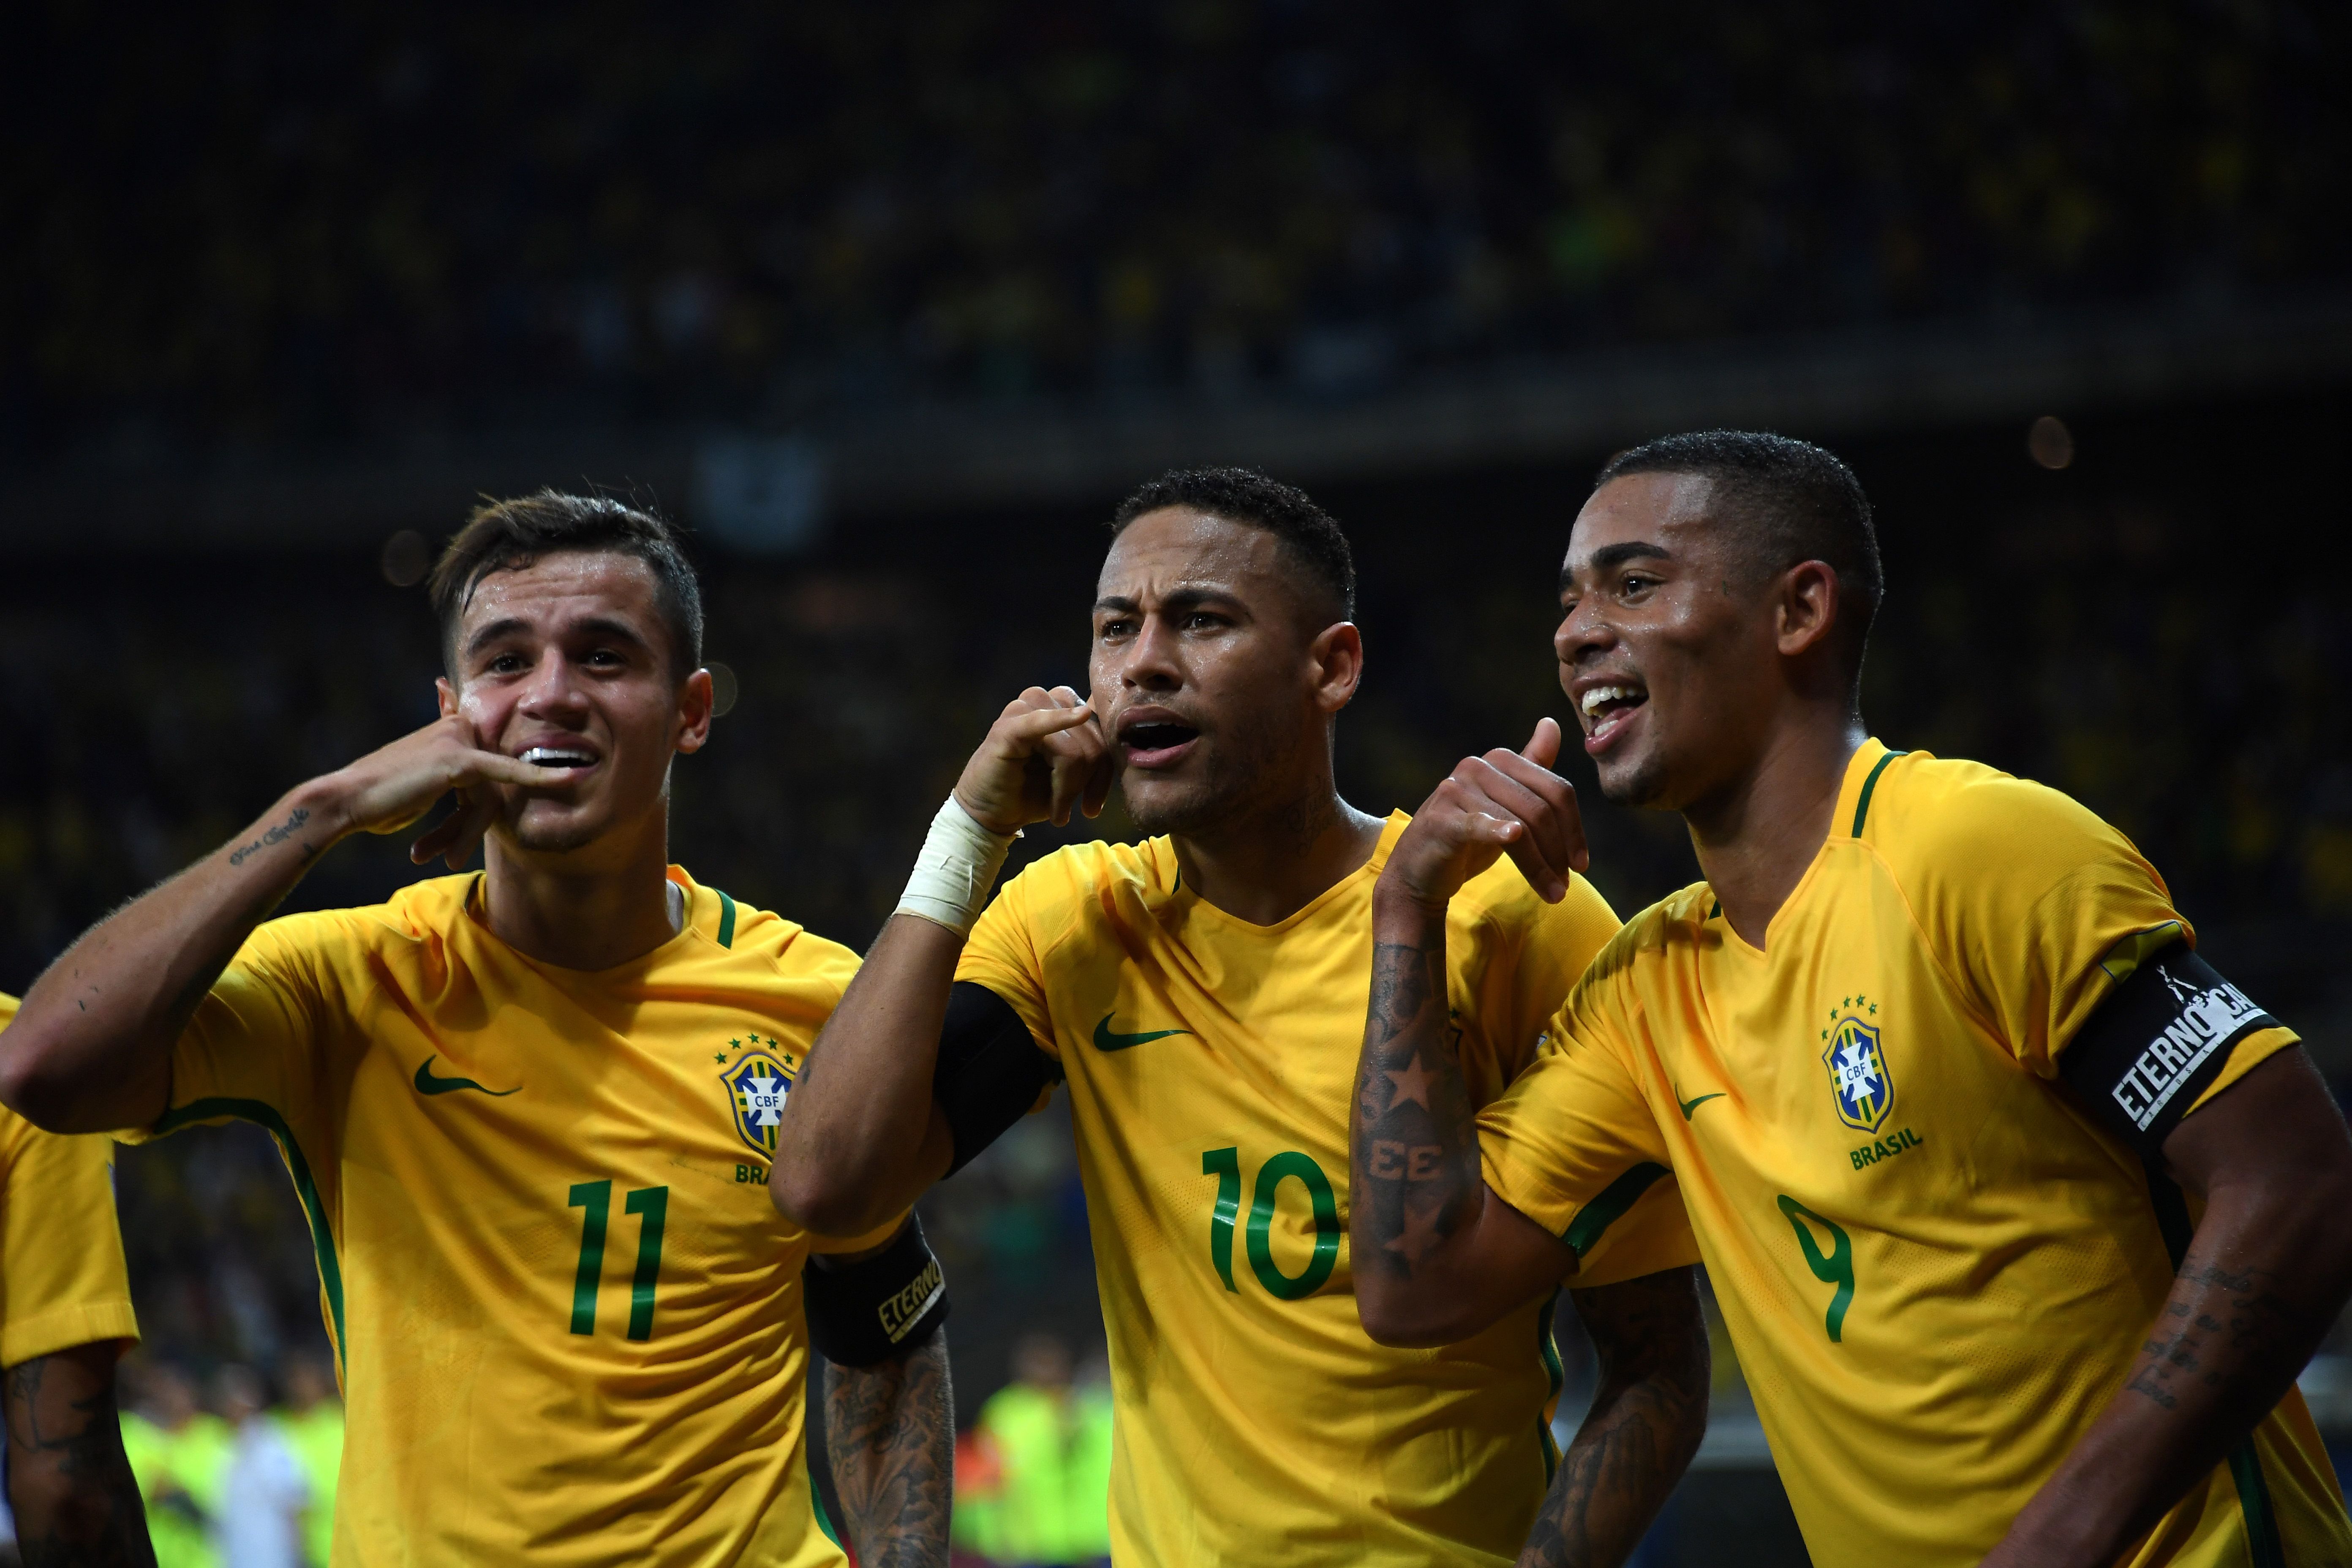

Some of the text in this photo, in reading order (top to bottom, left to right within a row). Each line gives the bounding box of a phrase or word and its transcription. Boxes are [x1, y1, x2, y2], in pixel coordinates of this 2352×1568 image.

[754, 1095, 779, 1108] CBF
[1846, 1062, 1866, 1081] CBF
[2112, 1004, 2217, 1122] ETERNO
[1849, 1128, 1924, 1171] BRASIL
[568, 1179, 669, 1342] 11
[1202, 1146, 1341, 1301] 10
[1777, 1194, 1855, 1343] 9
